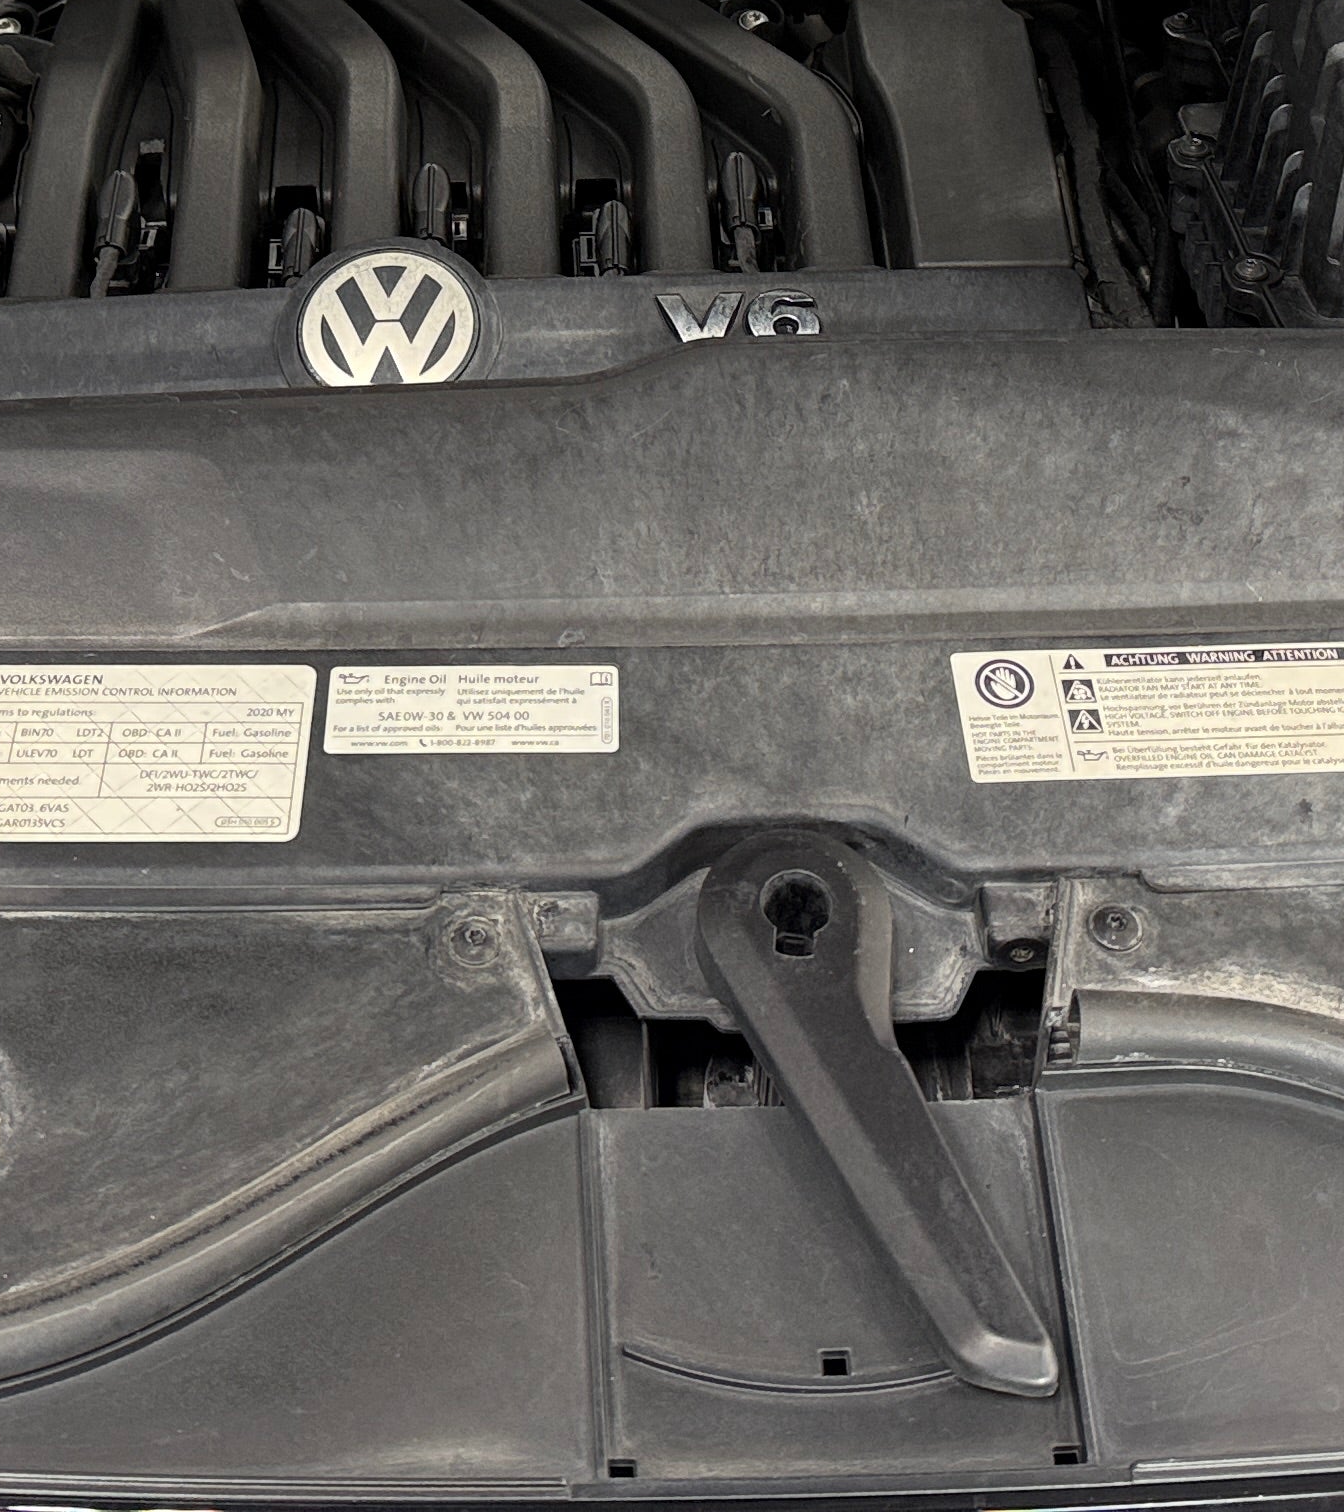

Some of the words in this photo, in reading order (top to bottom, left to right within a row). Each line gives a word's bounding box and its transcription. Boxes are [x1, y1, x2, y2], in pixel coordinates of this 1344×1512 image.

[655, 288, 820, 343] V6
[1110, 653, 1179, 666] ACHTUNG
[1185, 651, 1256, 664] WARNING
[1262, 648, 1339, 661] ATTENTION
[0, 674, 104, 685] VOLKSWAGEN
[384, 674, 427, 687] Engine
[429, 674, 447, 685] Oil
[458, 673, 491, 684] Huile
[494, 674, 540, 684] moteur
[45, 687, 99, 696] EMISSION
[102, 687, 154, 697] CONTROL
[158, 687, 238, 697] INFORMATION
[336, 688, 353, 696] Use
[354, 688, 374, 697] only
[375, 687, 386, 695] oil
[386, 687, 404, 695] that
[405, 688, 446, 697] expressly
[457, 688, 489, 696] Utilisez
[491, 688, 545, 697] uniquement
[335, 697, 374, 706] complies
[456, 697, 471, 706] qui
[473, 697, 507, 705] satisfait
[17, 707, 29, 717] to
[246, 707, 273, 717] 2020
[276, 707, 295, 717] MY
[378, 711, 402, 721] SAE
[403, 711, 444, 721] 0W-30
[446, 711, 456, 721] &
[463, 711, 484, 721] VW
[487, 711, 511, 720] 504
[513, 711, 530, 720] 00
[21, 727, 54, 737] BIN70
[76, 727, 105, 738] LDT2
[156, 728, 172, 738] CA
[243, 728, 293, 738] Gasoline
[383, 725, 424, 734] approved
[455, 724, 476, 732] Pour
[495, 724, 513, 732] liste
[514, 724, 546, 732] d'huiles
[548, 724, 597, 734] approuvées
[16, 749, 58, 758] ULEV70
[72, 748, 94, 758] LDT
[152, 749, 168, 759] CA
[240, 749, 289, 759] Gasoline
